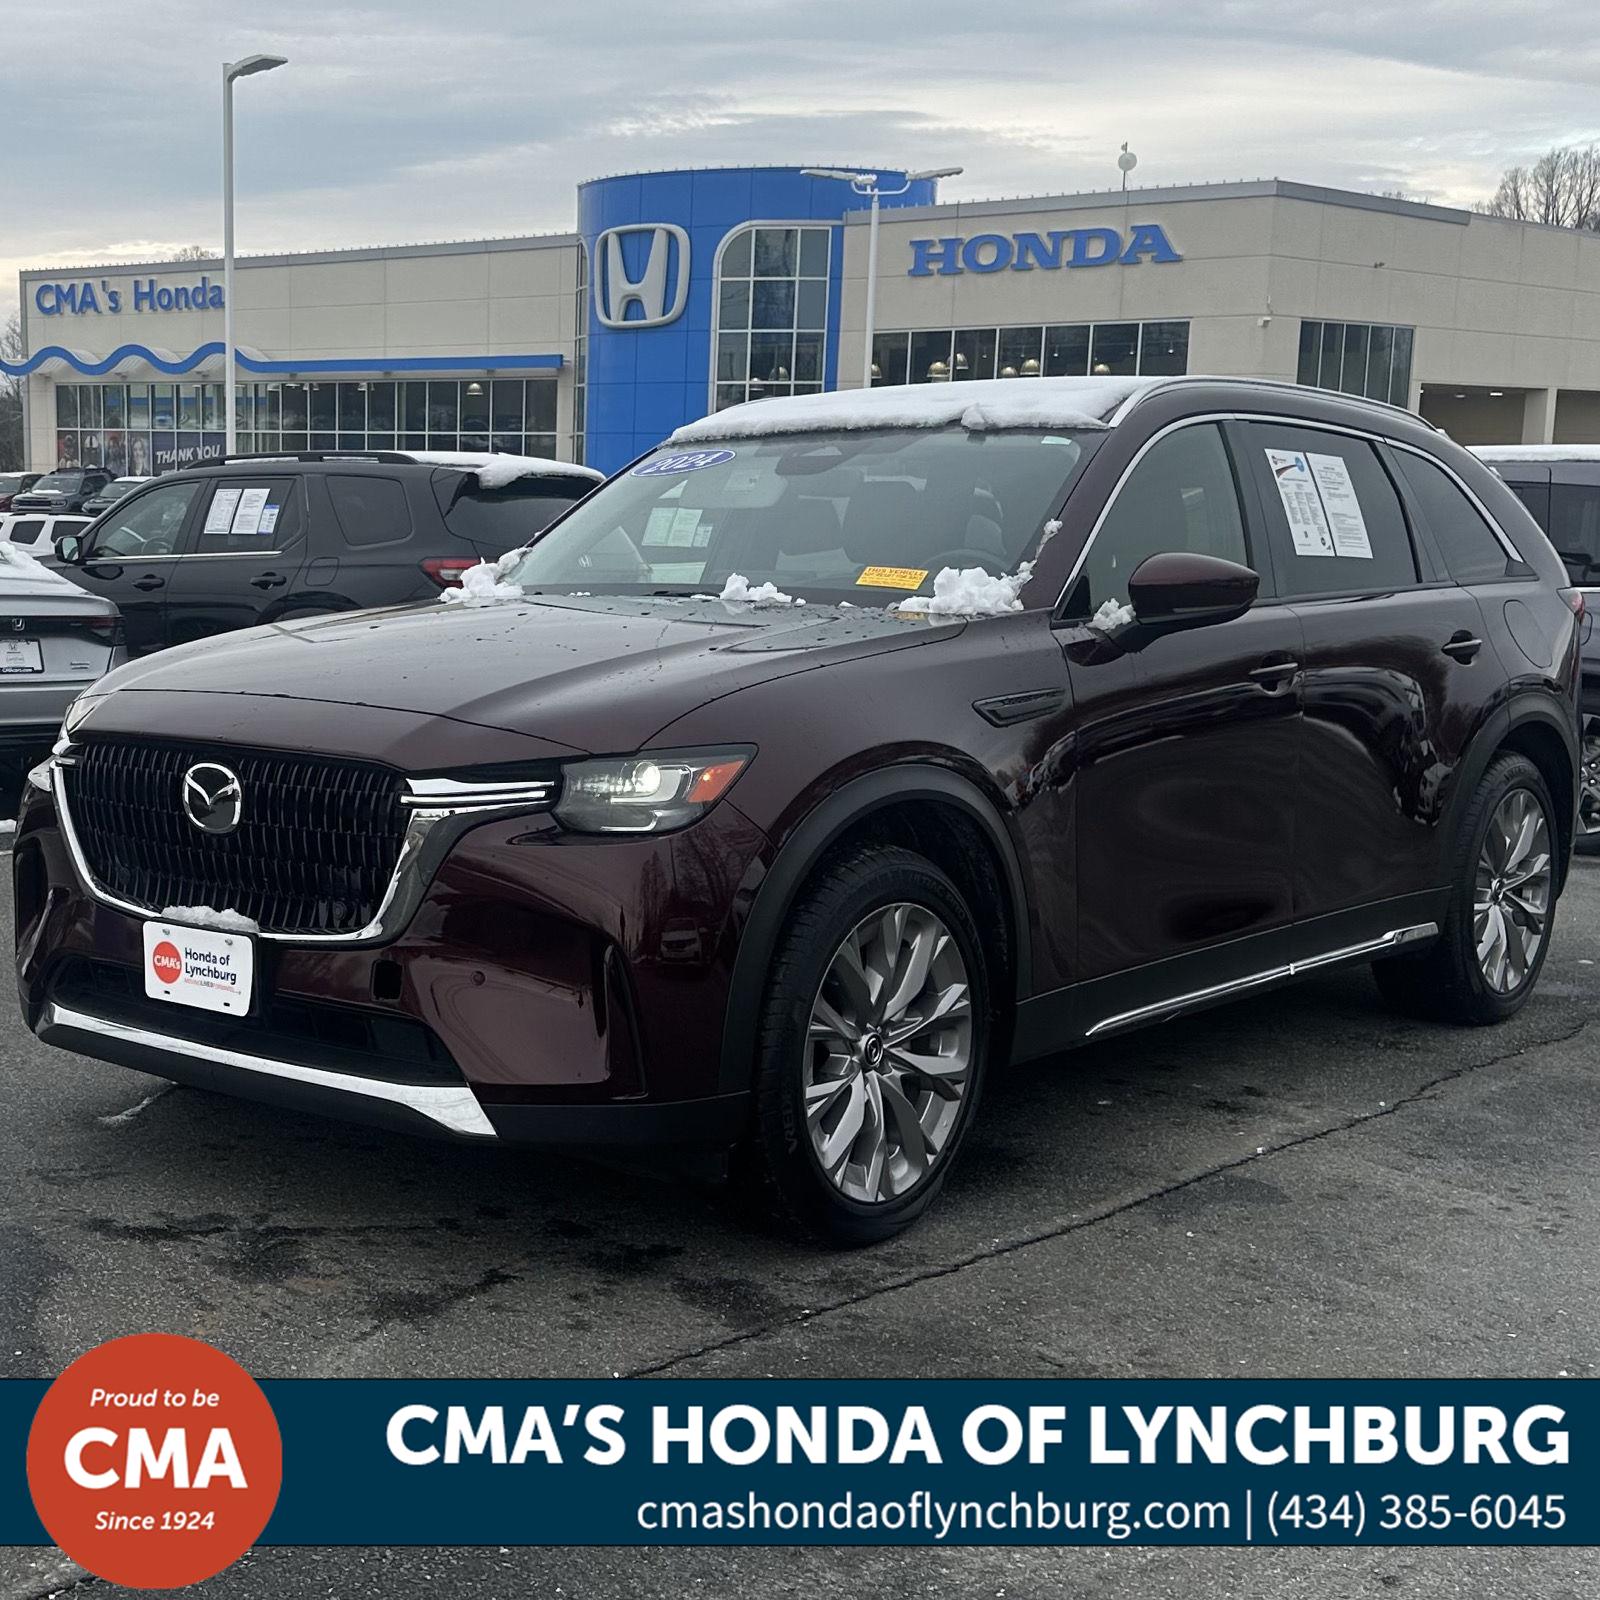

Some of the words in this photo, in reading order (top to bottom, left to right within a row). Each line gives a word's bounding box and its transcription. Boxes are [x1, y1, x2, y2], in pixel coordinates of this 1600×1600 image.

[908, 223, 1183, 277] HONDA
[35, 279, 122, 315] CMA's
[133, 276, 226, 312] Honda
[156, 447, 195, 465] THANK
[196, 444, 221, 460] YOU
[641, 451, 724, 474] 2024
[154, 955, 180, 970] CMA's
[185, 947, 217, 964] Honda
[220, 955, 230, 965] of
[185, 963, 236, 985] Lynchburg
